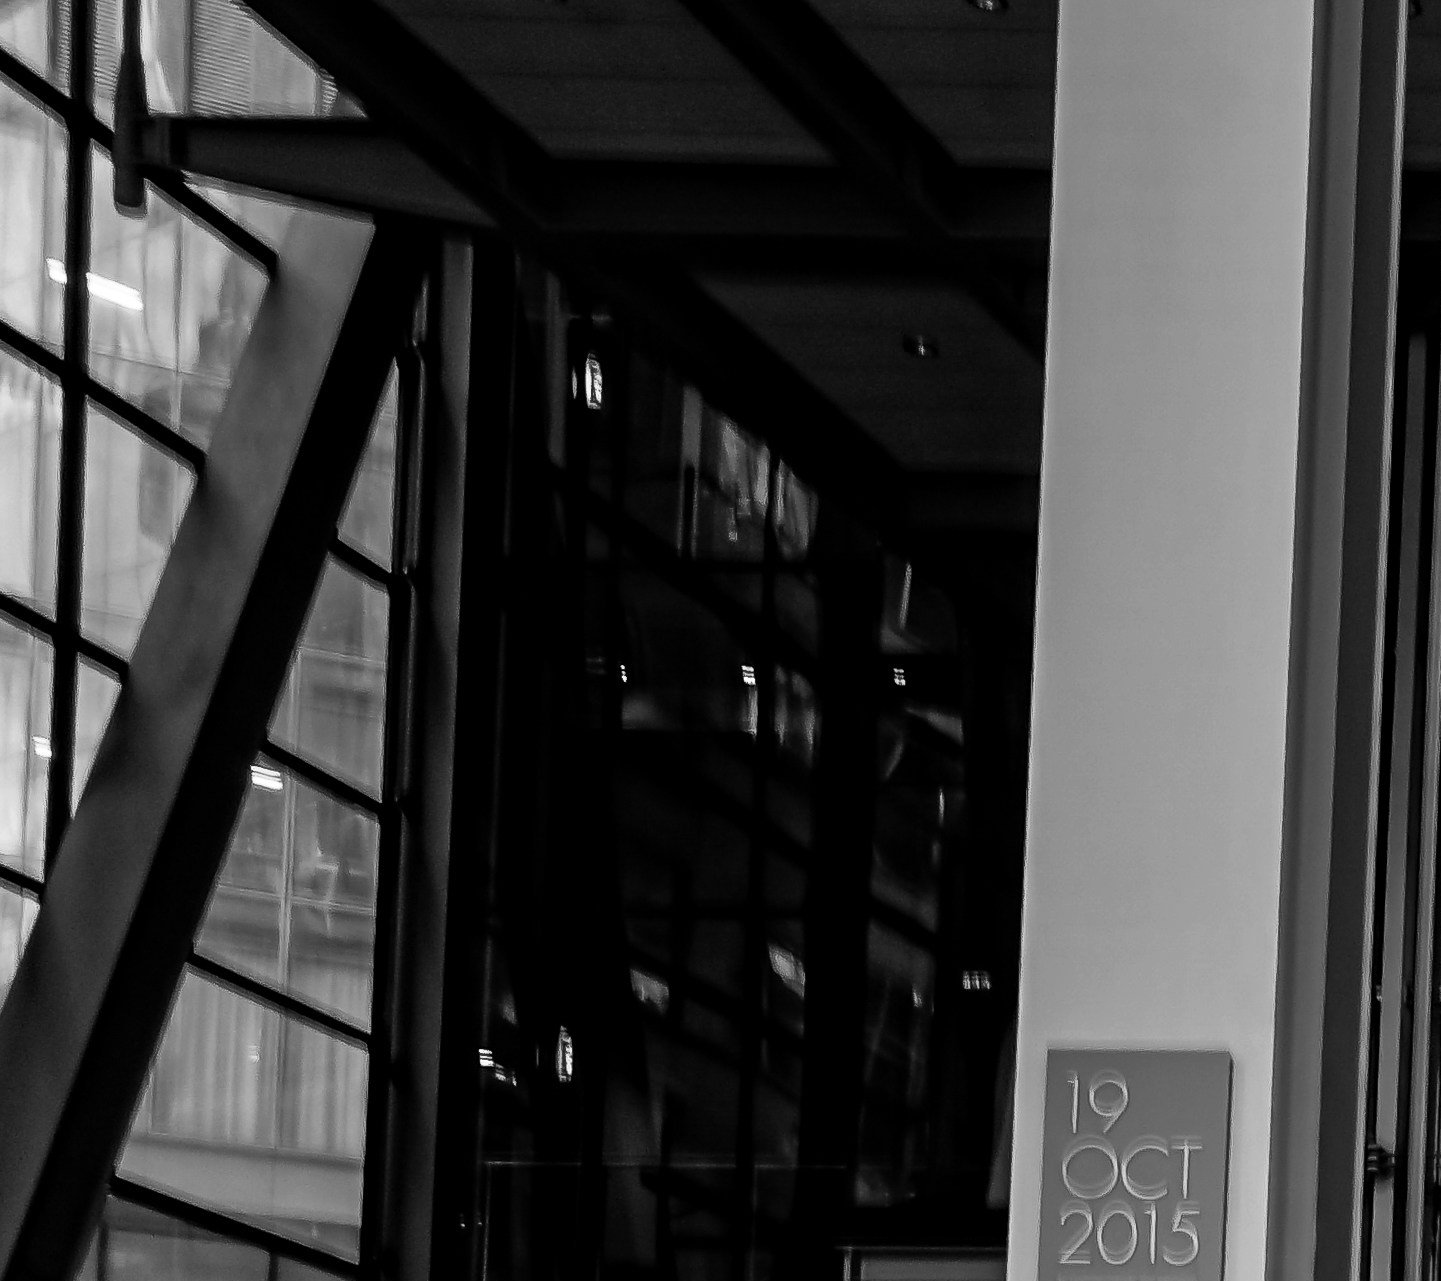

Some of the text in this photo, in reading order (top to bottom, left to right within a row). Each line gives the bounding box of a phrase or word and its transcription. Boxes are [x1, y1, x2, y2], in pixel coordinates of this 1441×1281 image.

[1067, 1069, 1129, 1134] 19
[1062, 1135, 1202, 1200] OCT
[1059, 1200, 1199, 1266] 2015
